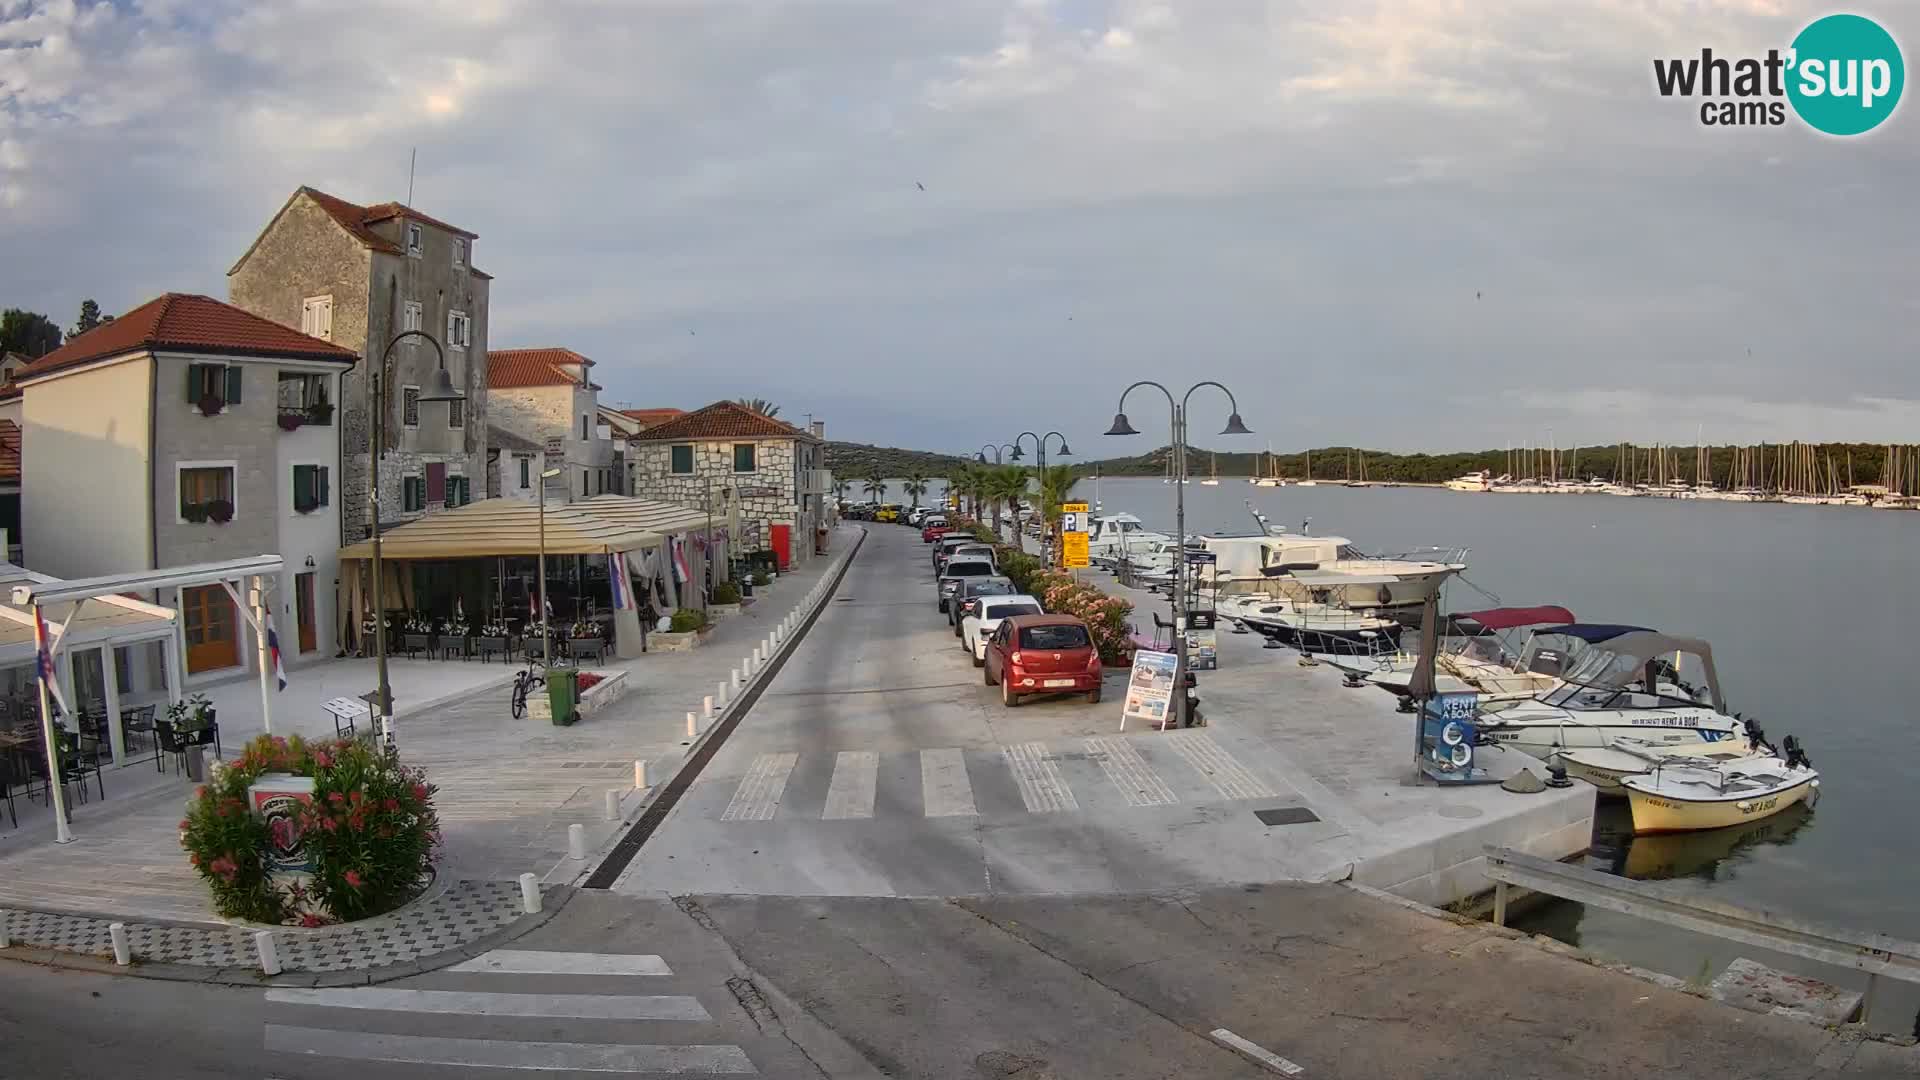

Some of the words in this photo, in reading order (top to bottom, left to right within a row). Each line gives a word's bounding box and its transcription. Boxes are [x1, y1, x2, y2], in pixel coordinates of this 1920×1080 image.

[1065, 514, 1076, 530] P
[1443, 698, 1475, 710] RENT
[1443, 710, 1449, 719] A
[1451, 709, 1473, 719] BOAT
[1662, 717, 1677, 726] RENT
[1678, 717, 1682, 726] A
[1684, 716, 1699, 726] BOAT
